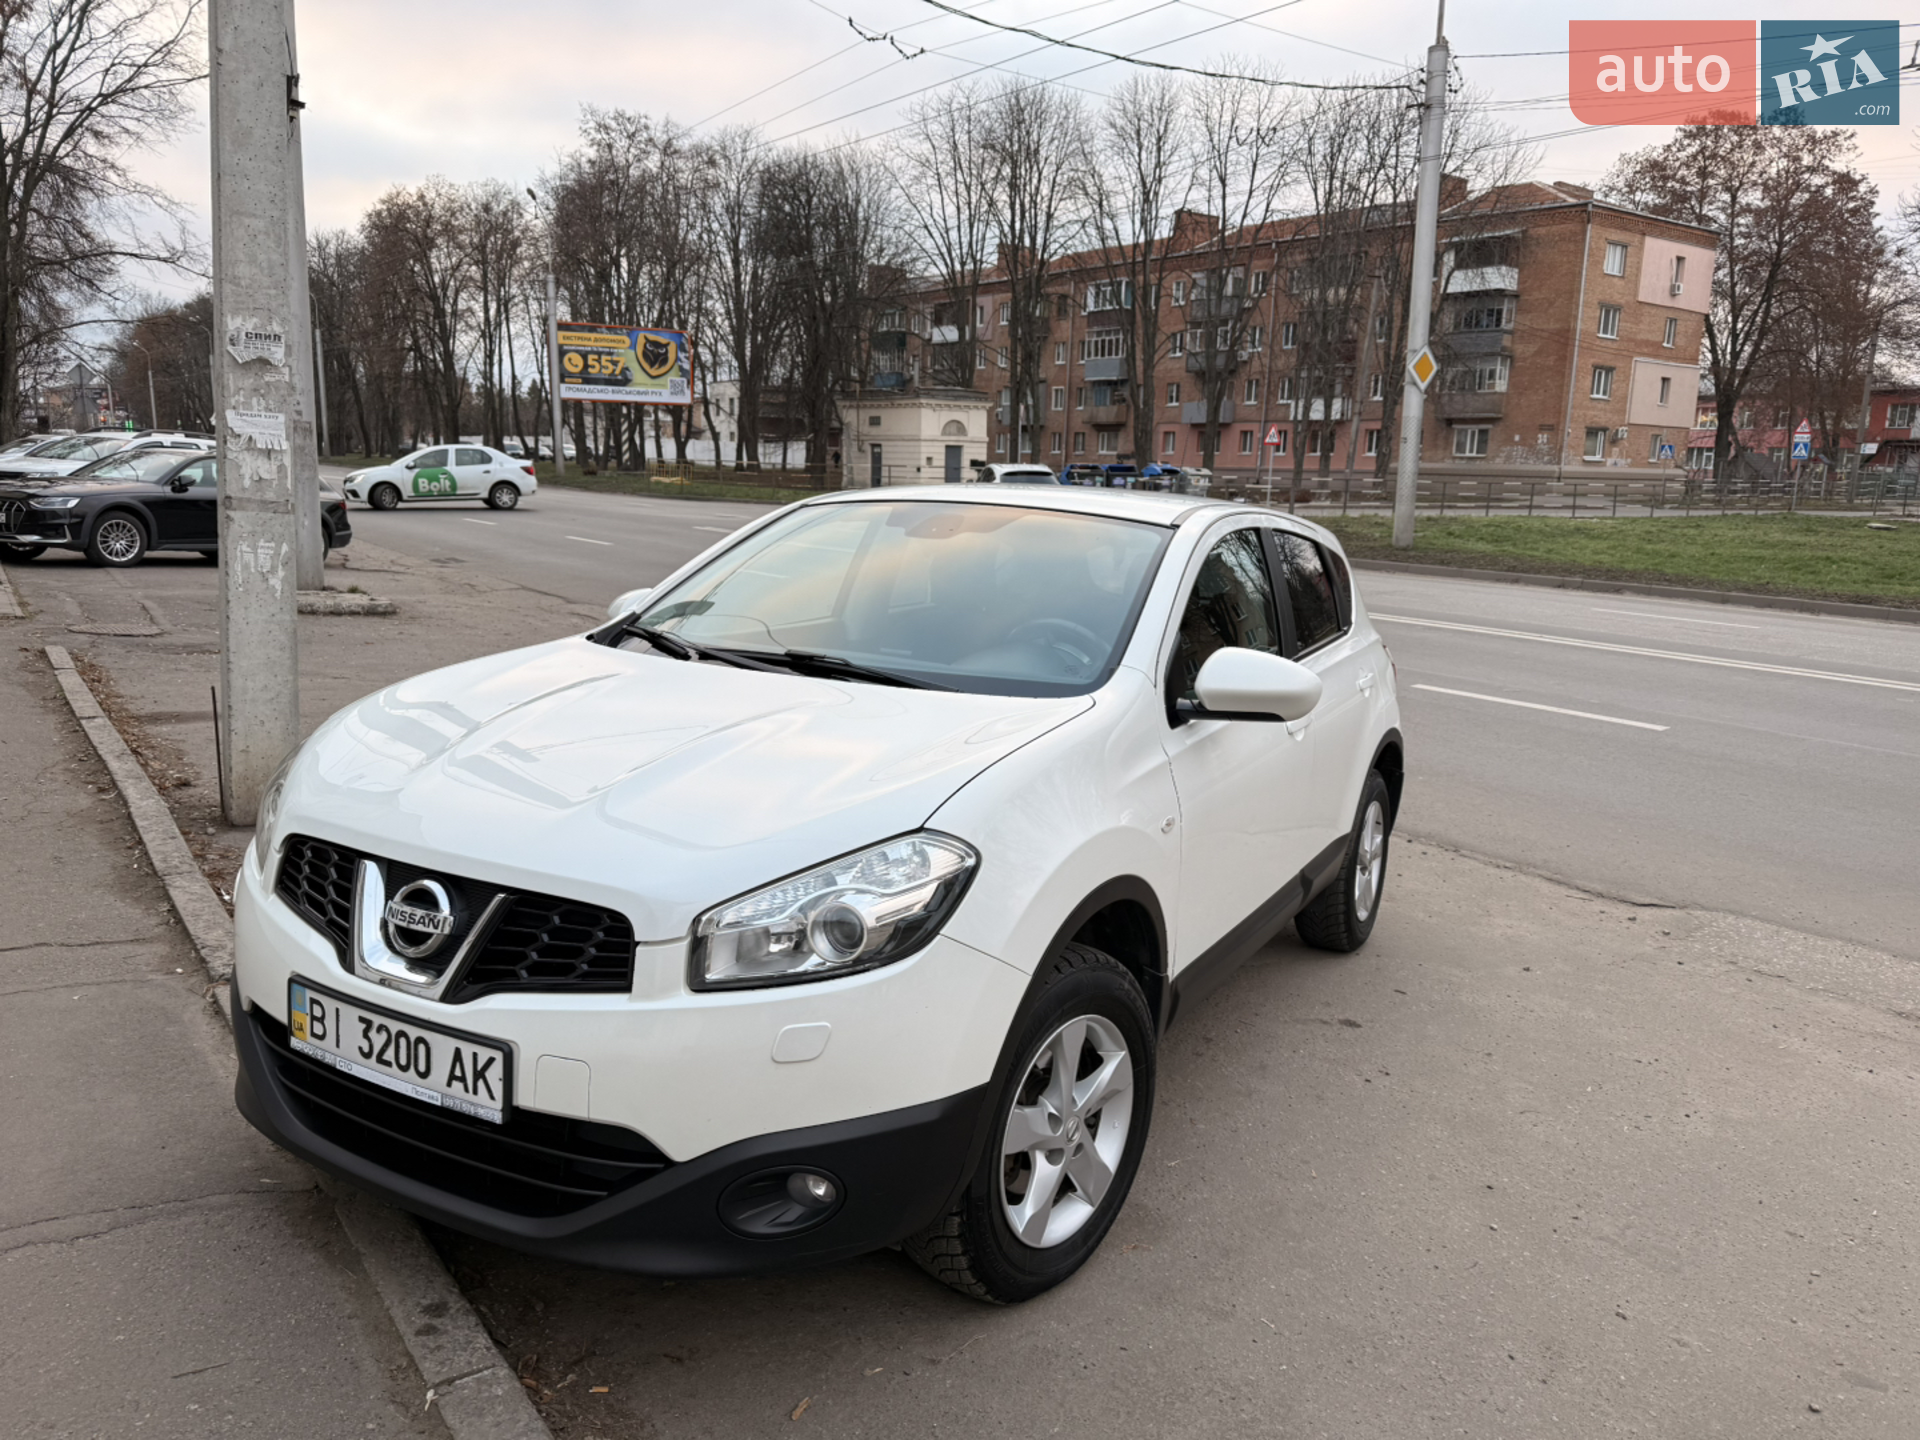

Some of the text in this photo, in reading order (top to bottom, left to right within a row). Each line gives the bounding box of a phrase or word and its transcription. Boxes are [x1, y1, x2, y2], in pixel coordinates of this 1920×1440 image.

[593, 336, 626, 344] ДОПОМОГА
[587, 354, 626, 376] 557
[418, 474, 451, 493] Bolt
[388, 907, 441, 930] NISSAN
[293, 1020, 305, 1033] UA
[309, 996, 340, 1049] BI
[358, 1015, 431, 1080] 3200
[446, 1046, 497, 1101] AK
